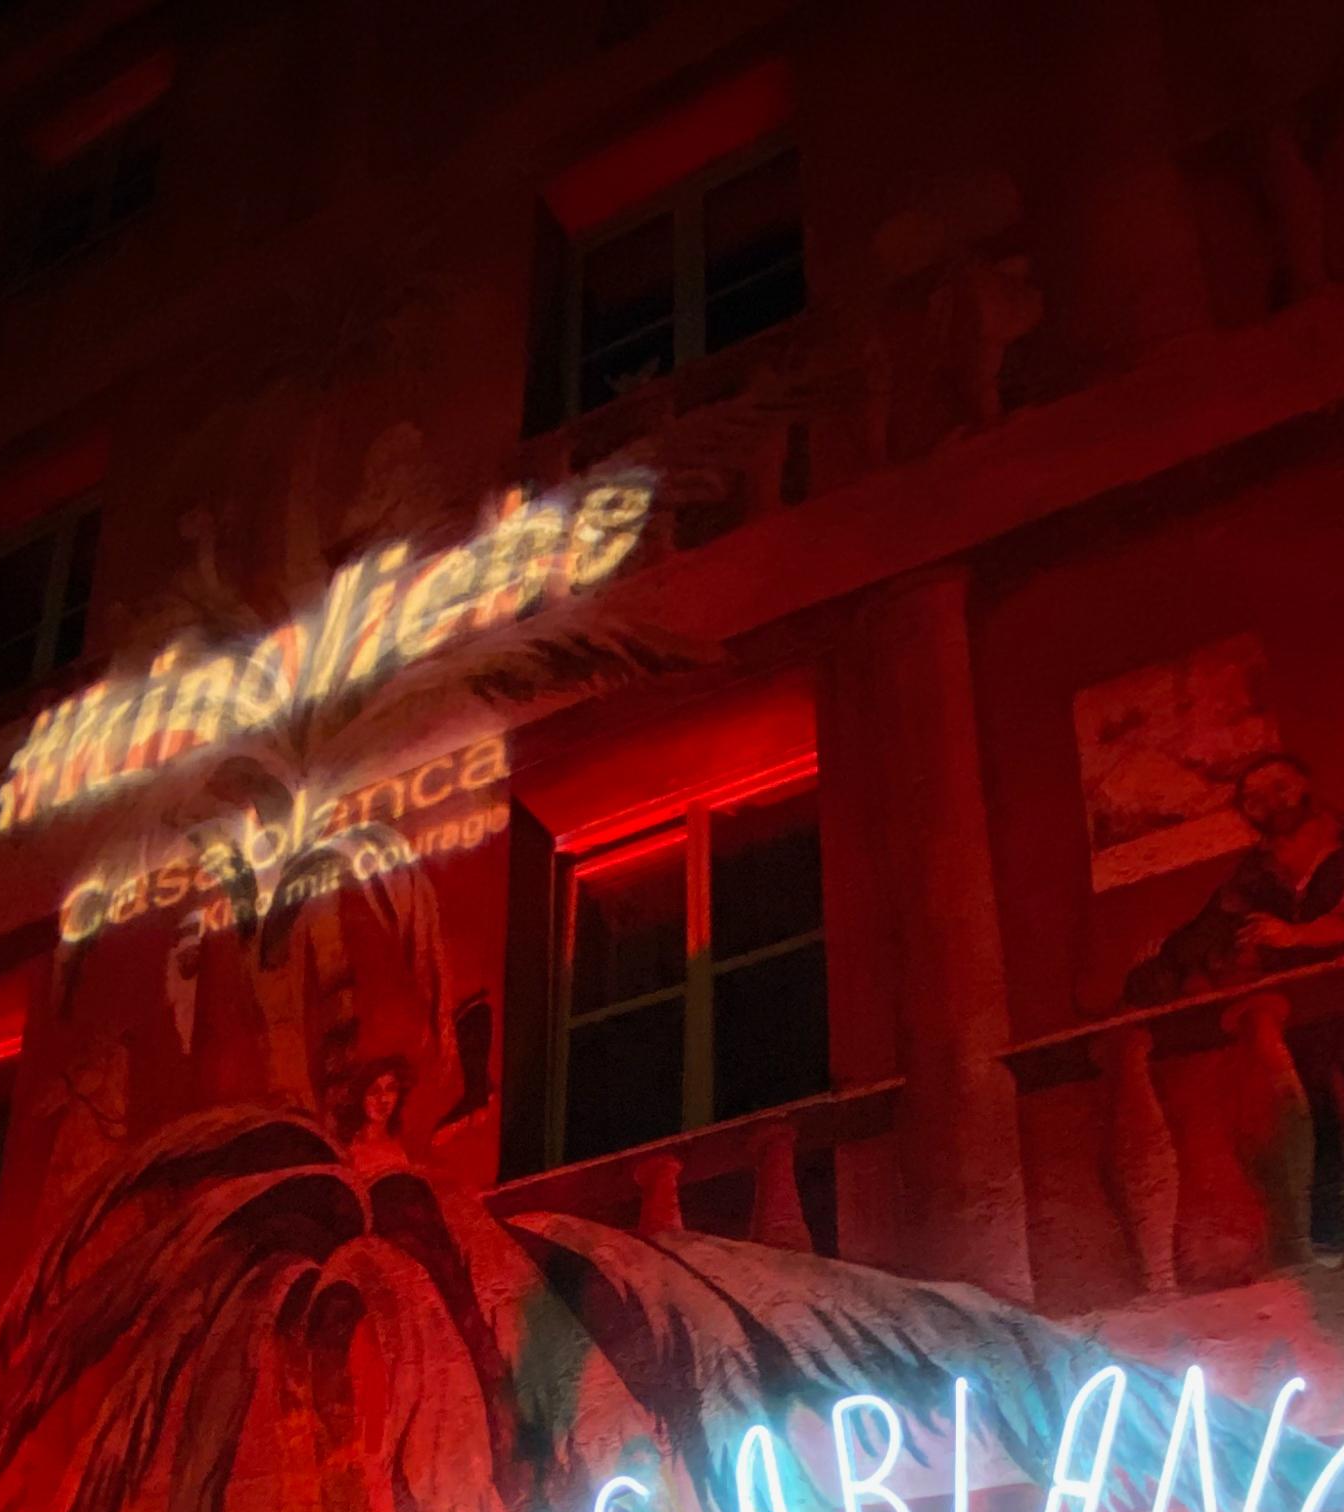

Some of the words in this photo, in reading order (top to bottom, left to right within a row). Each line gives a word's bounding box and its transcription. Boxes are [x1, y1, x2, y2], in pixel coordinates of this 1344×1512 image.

[58, 733, 510, 943] Casablanca
[199, 890, 273, 938] Kio
[286, 866, 341, 906] mit
